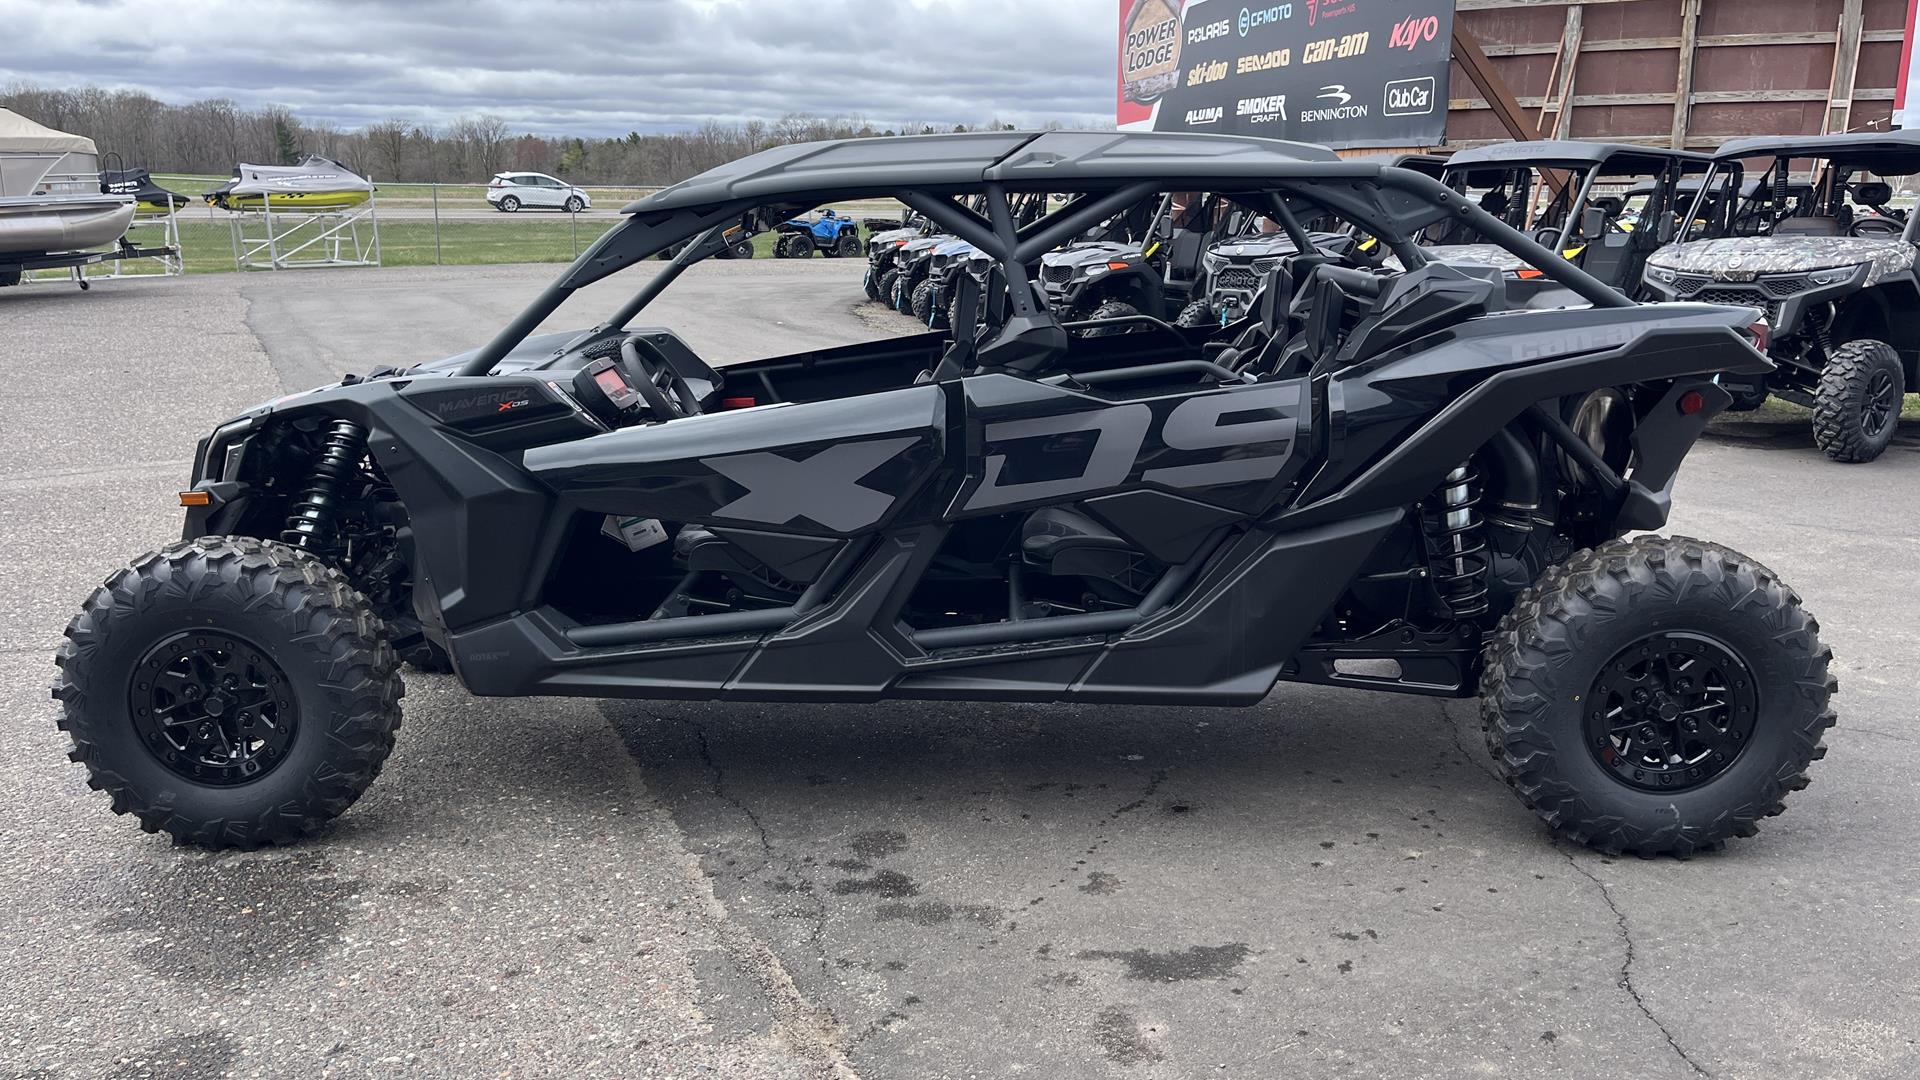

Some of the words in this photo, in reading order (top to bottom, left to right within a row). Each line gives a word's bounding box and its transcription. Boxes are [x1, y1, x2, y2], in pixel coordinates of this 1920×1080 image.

[1250, 4, 1292, 26] CFMOTO
[1126, 19, 1177, 55] POWER
[1188, 20, 1230, 44] POLARIS
[1389, 15, 1439, 50] KAYO
[1128, 42, 1174, 72] LODGE
[1185, 106, 1223, 125] ALUMA
[1236, 95, 1287, 120] SMOKER
[1250, 113, 1280, 123] CRAFT
[1301, 105, 1368, 122] BENNINGTON
[438, 387, 530, 413] MAVERICK
